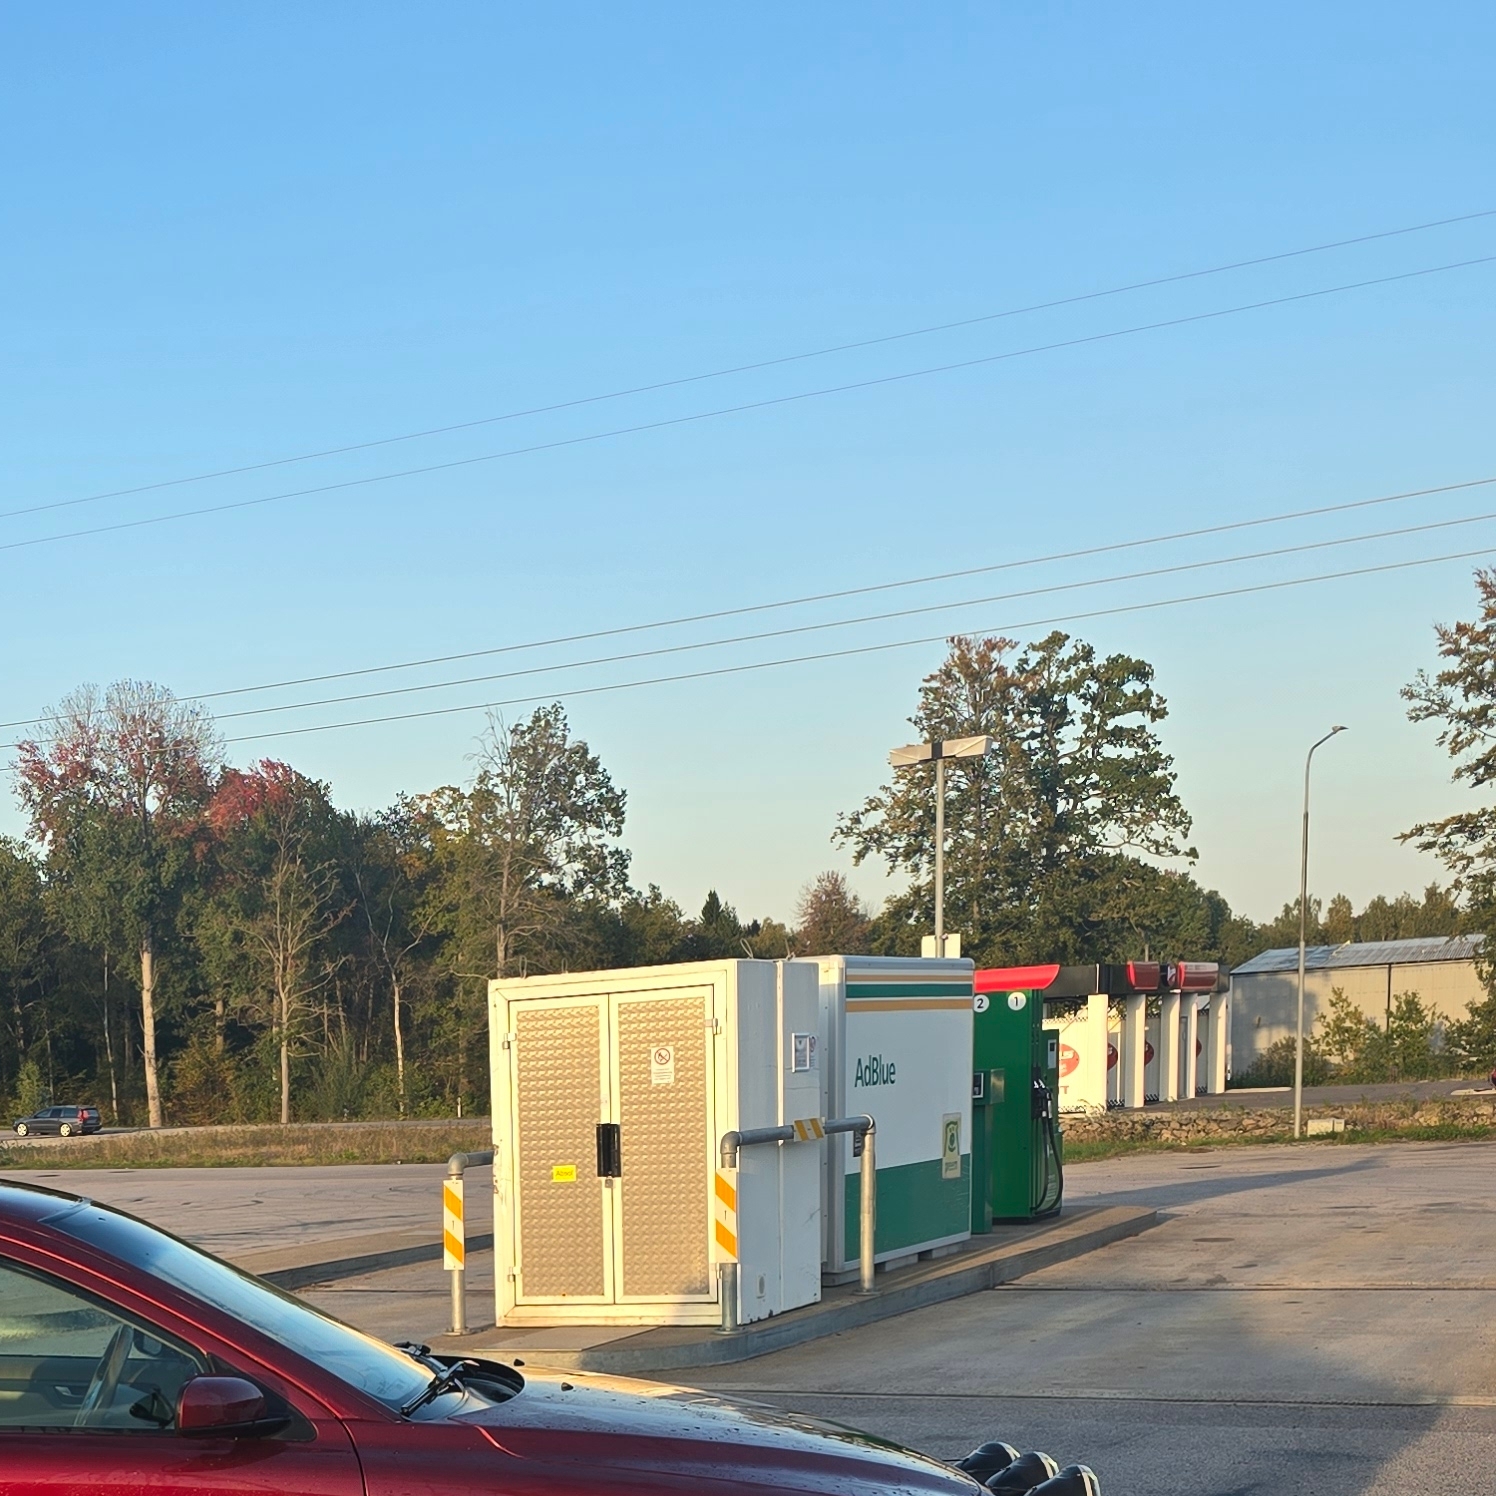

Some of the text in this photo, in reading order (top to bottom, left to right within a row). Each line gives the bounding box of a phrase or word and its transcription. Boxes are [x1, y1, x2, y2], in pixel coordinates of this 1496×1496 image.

[977, 998, 984, 1009] 2
[1014, 996, 1019, 1007] 1
[854, 1054, 896, 1087] AdBlue
